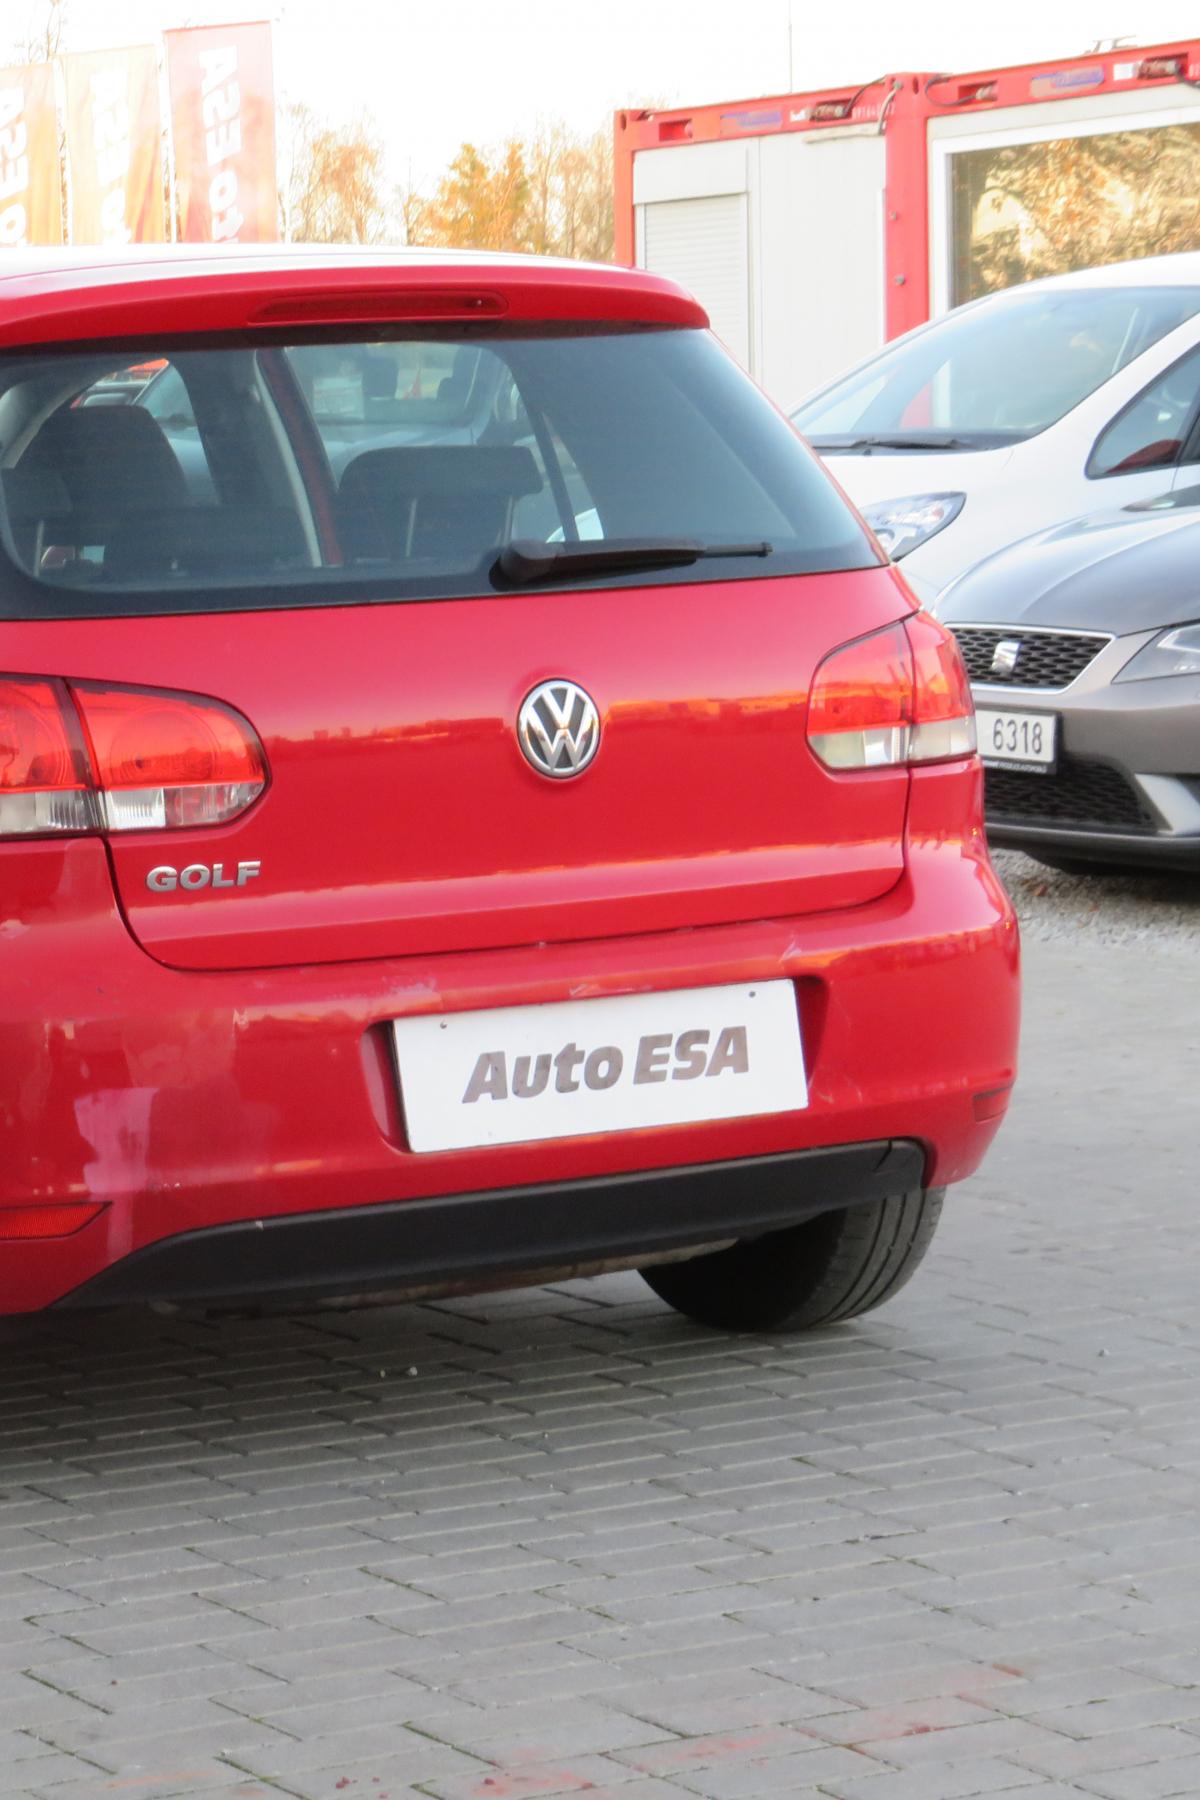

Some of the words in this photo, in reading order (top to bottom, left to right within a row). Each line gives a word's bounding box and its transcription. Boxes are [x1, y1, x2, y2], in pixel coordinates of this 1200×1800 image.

[517, 679, 599, 778] VW
[993, 718, 1042, 754] 6318
[146, 861, 261, 892] GOLF
[462, 1042, 624, 1103] Auto
[633, 1026, 749, 1085] ESA
